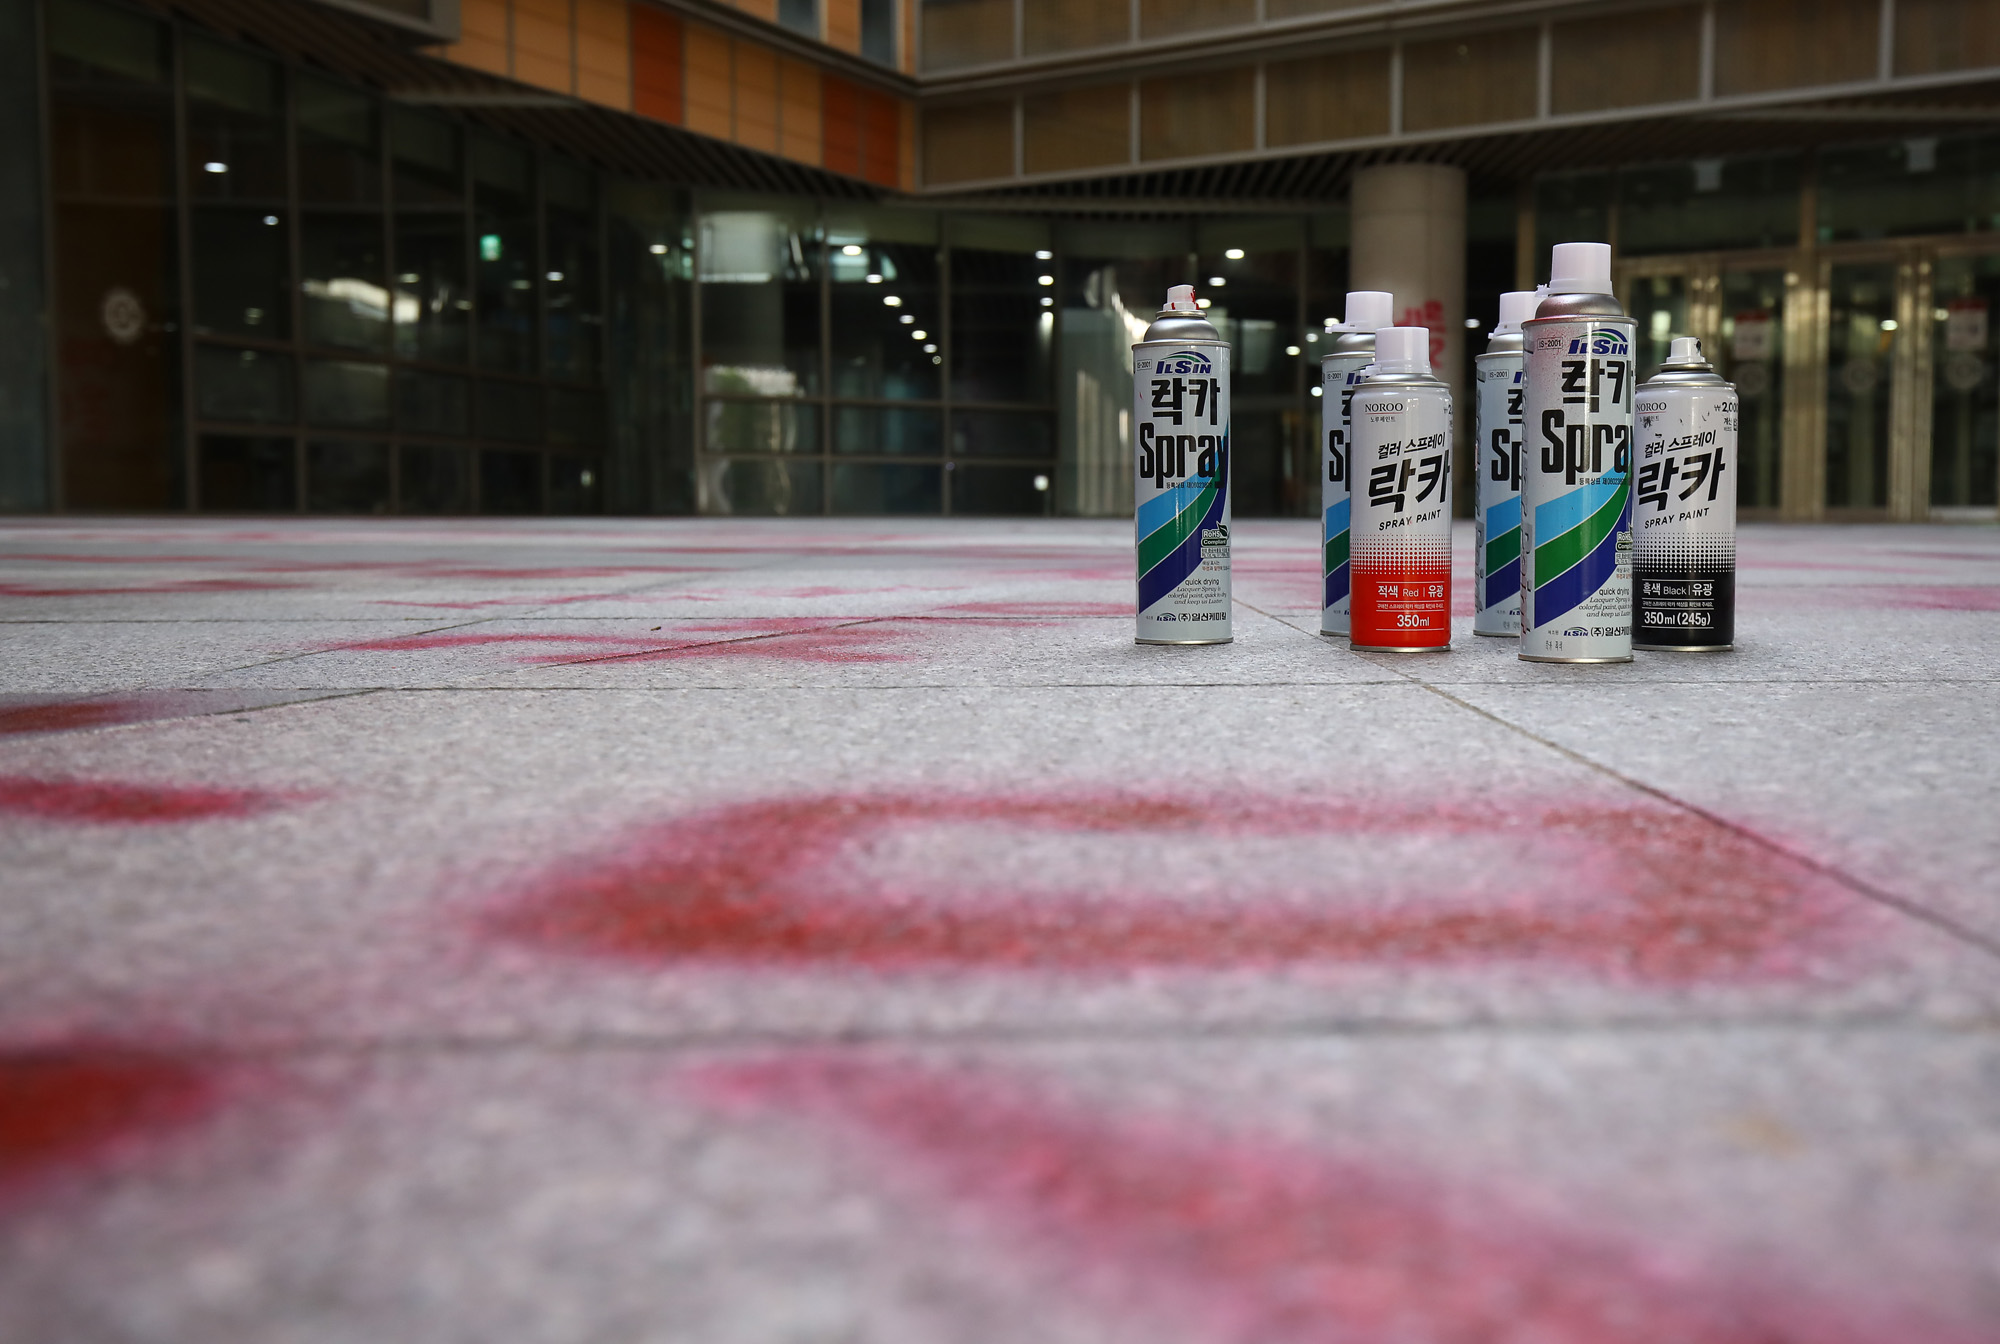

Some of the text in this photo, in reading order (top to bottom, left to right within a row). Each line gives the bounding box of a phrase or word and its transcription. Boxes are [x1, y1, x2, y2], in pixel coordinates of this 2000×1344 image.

[1539, 340, 1561, 348] IS-2001
[1567, 339, 1629, 355] ILSIN
[1156, 360, 1212, 374] ILSIN
[1364, 402, 1404, 412] NOROO
[1636, 402, 1667, 412] NOROO
[1378, 432, 1446, 460] 컬러 스프레이
[1644, 429, 1716, 459] 컬러 스프레이
[1139, 422, 1228, 489] Spray
[1368, 449, 1451, 513] 락카
[1638, 447, 1726, 512] 락카
[1379, 509, 1441, 531] SPRAY PAINT
[1644, 507, 1709, 529] SPRAY PAINT
[1377, 584, 1444, 598] 적색 Red 유광
[1599, 588, 1616, 596] quick
[1642, 582, 1714, 596] 흑색 Black 유광
[1578, 603, 1602, 611] colorful
[1396, 614, 1430, 627] 350ml
[1644, 611, 1711, 627] 350ml (245g)
